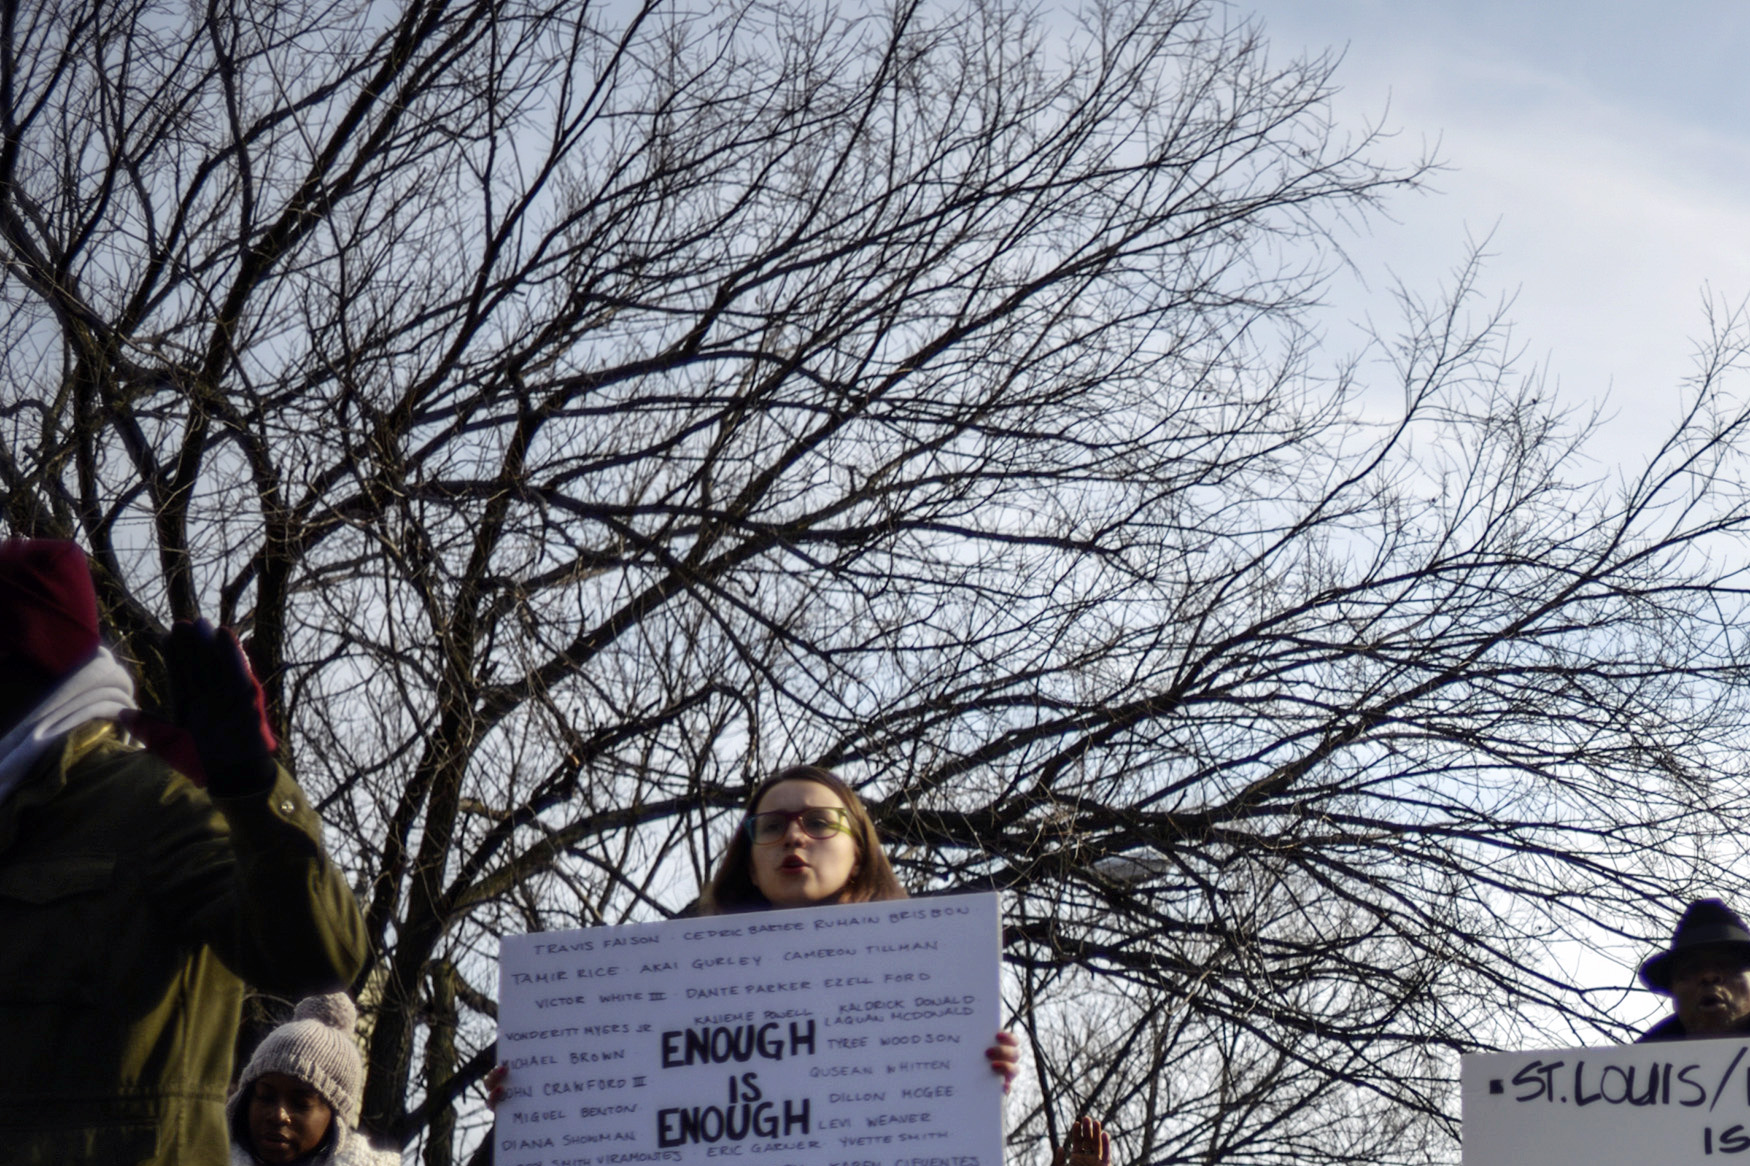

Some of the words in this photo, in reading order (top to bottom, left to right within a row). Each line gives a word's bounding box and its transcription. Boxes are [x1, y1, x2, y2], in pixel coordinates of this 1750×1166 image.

[534, 941, 594, 955] TRAVIS
[602, 936, 659, 948] FAISON
[683, 930, 742, 941] CEDRIC
[889, 906, 970, 924] BRISBON
[511, 971, 568, 986] TAMIR
[577, 966, 619, 980] RICE
[639, 962, 678, 974] AKAI
[692, 956, 762, 968] GURLEY
[784, 948, 856, 961] CAMERON
[865, 940, 938, 954] TILLMAN
[535, 996, 585, 1009] VICTOR
[598, 992, 643, 1004] WHITE
[686, 986, 739, 1000] DANTE
[744, 981, 811, 994] PARKER
[824, 977, 873, 988] EZELL
[884, 972, 931, 984] FORD
[914, 996, 975, 1007] DONALD
[764, 1008, 813, 1020] POWELL
[891, 1006, 974, 1020] MCDONALD
[584, 1024, 629, 1036] MYERS
[662, 1020, 816, 1068] ENOUGH
[828, 1036, 868, 1050] TYREE
[881, 1034, 961, 1046] WOODSON
[570, 1050, 624, 1064] BROWN
[887, 1061, 951, 1074] WHITTEN
[543, 1079, 626, 1096] CRAWFORD
[729, 1071, 762, 1103] IS
[830, 1092, 886, 1103] DILLON
[902, 1086, 954, 1098] MCGEE
[512, 1110, 566, 1124] MIGUEL
[582, 1104, 638, 1118] BENTON
[818, 1118, 852, 1130] LEVI
[867, 1113, 931, 1128] WEAVER
[657, 1098, 810, 1148] ENOUGH
[502, 1138, 554, 1152] DIANA
[562, 1130, 636, 1146] SHOWMAN
[599, 1150, 682, 1165] VIRAMONTES
[706, 1146, 742, 1158] ERIC
[751, 1141, 821, 1153] GARNER
[840, 1135, 892, 1148] YVETTE
[899, 1131, 949, 1142] SMITH
